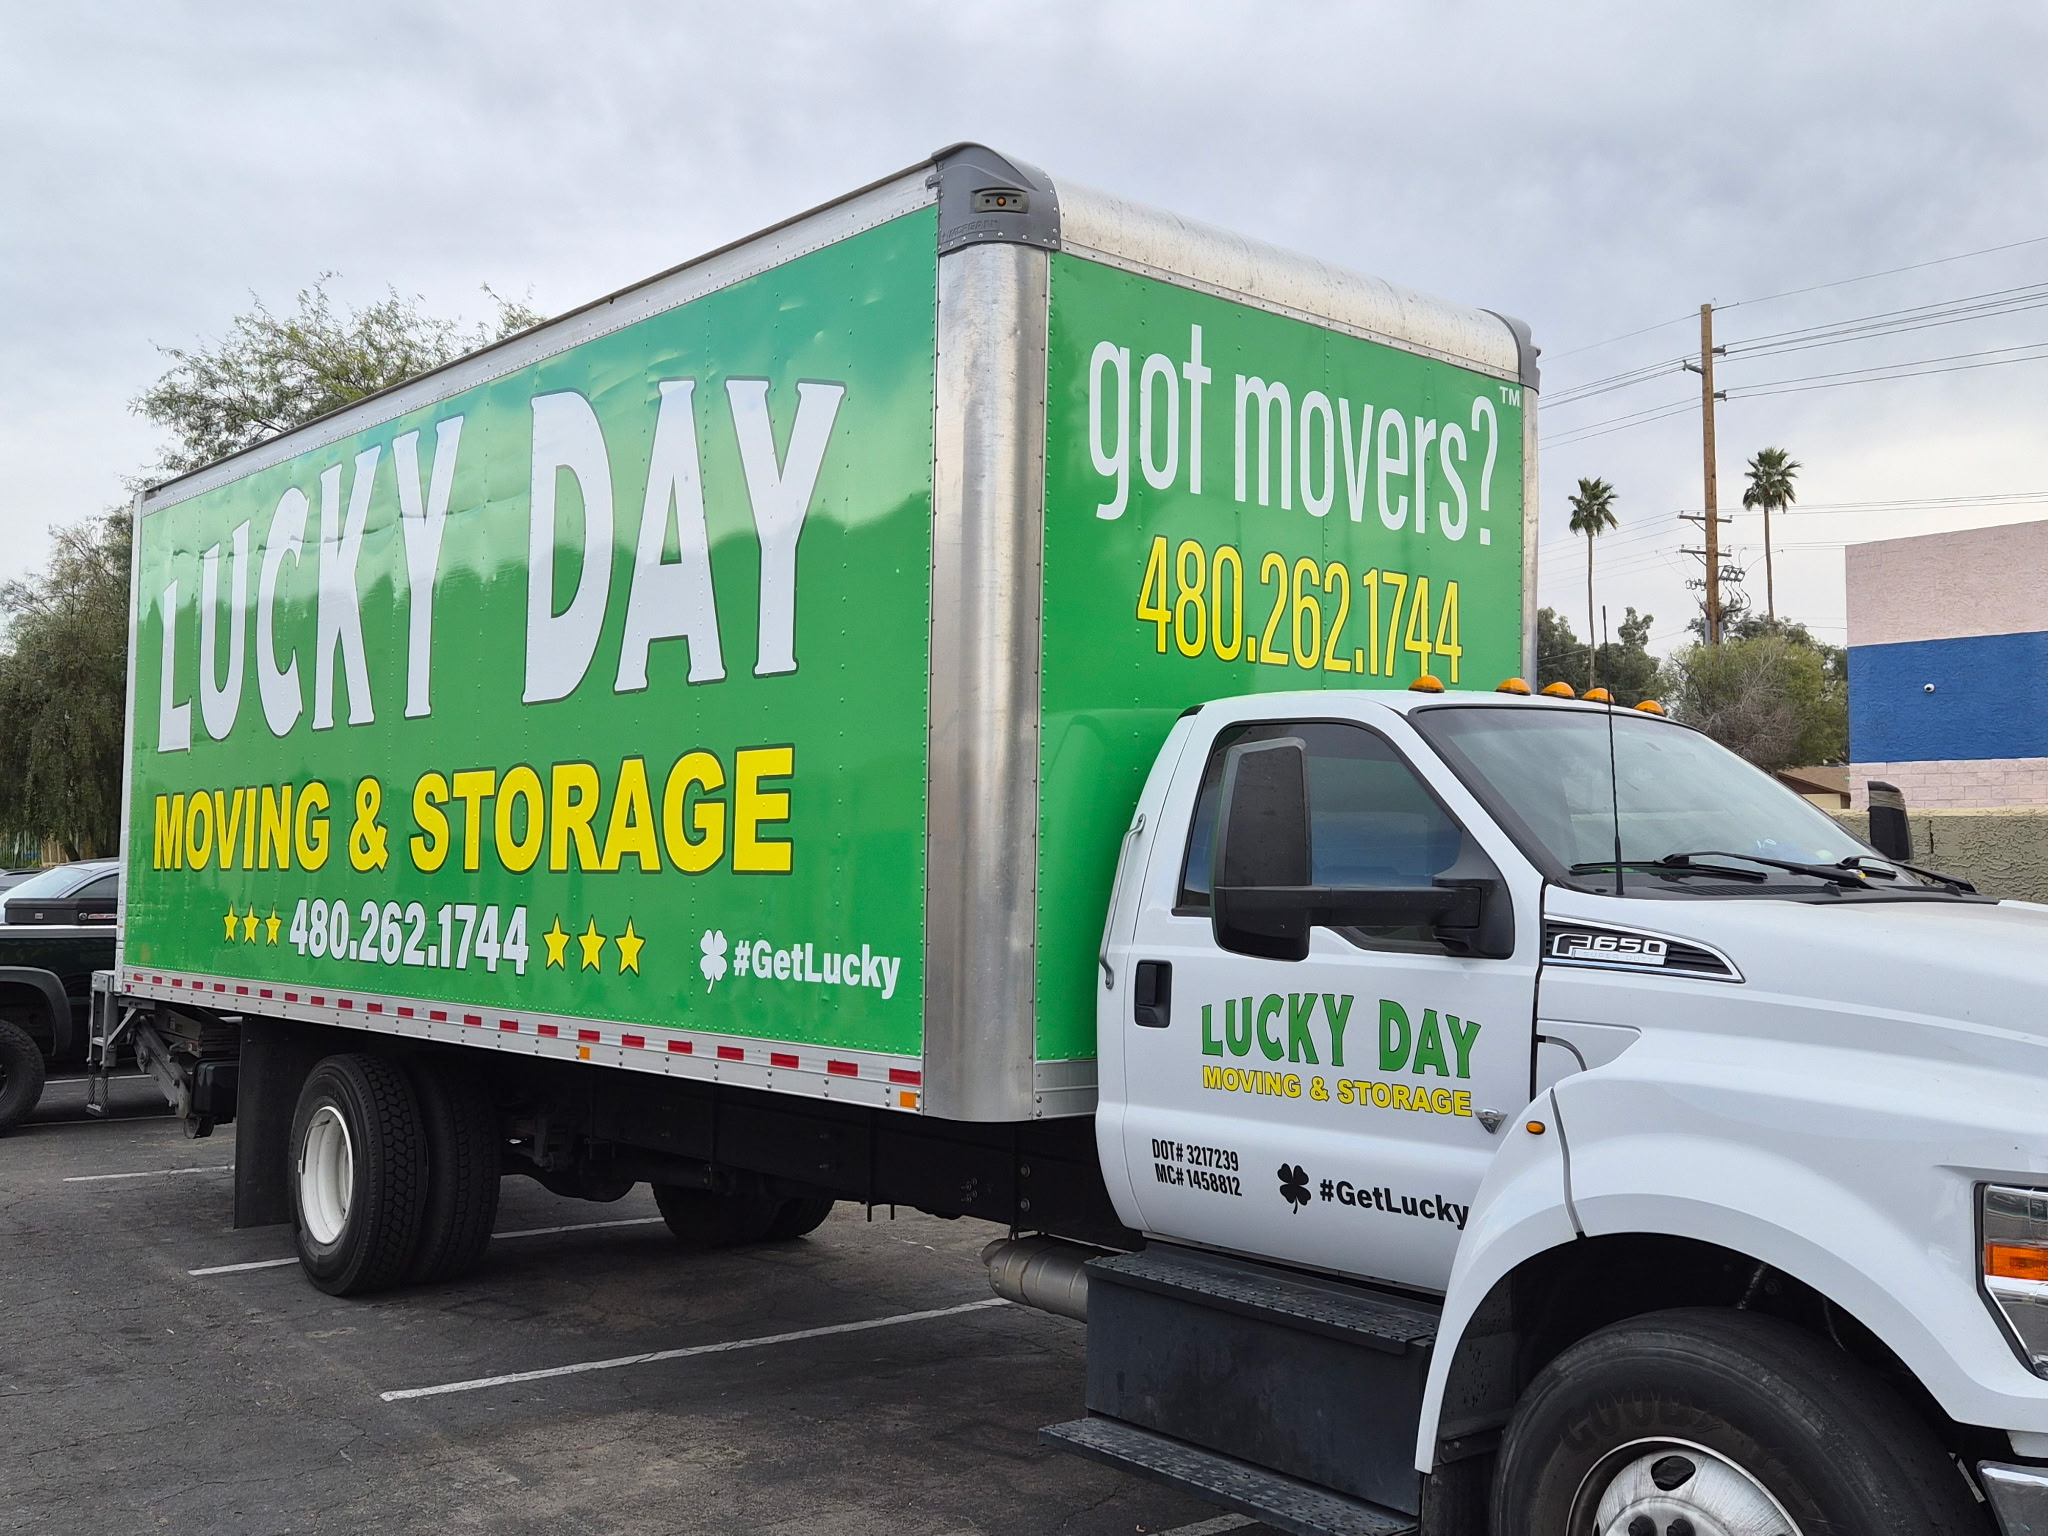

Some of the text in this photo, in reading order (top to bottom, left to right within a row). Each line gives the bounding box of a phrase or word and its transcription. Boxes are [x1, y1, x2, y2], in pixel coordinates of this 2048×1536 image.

[1088, 323, 1212, 520] got
[1234, 373, 1499, 546] movers?
[157, 377, 848, 753] LUCKY DAY
[1136, 535, 1463, 684] 480.262.1744
[152, 745, 795, 874] MOVING & STORAGE
[288, 898, 529, 975] 480.262.1744
[733, 939, 901, 1000] #GetLucky
[1201, 993, 1482, 1079] LUCKY DAY
[1202, 1065, 1473, 1117] MOVING & STORAGE
[1151, 1138, 1239, 1172] DOT# 3217239
[1154, 1163, 1242, 1197] MC# 1458812
[1320, 1178, 1470, 1231] #GetLucky
